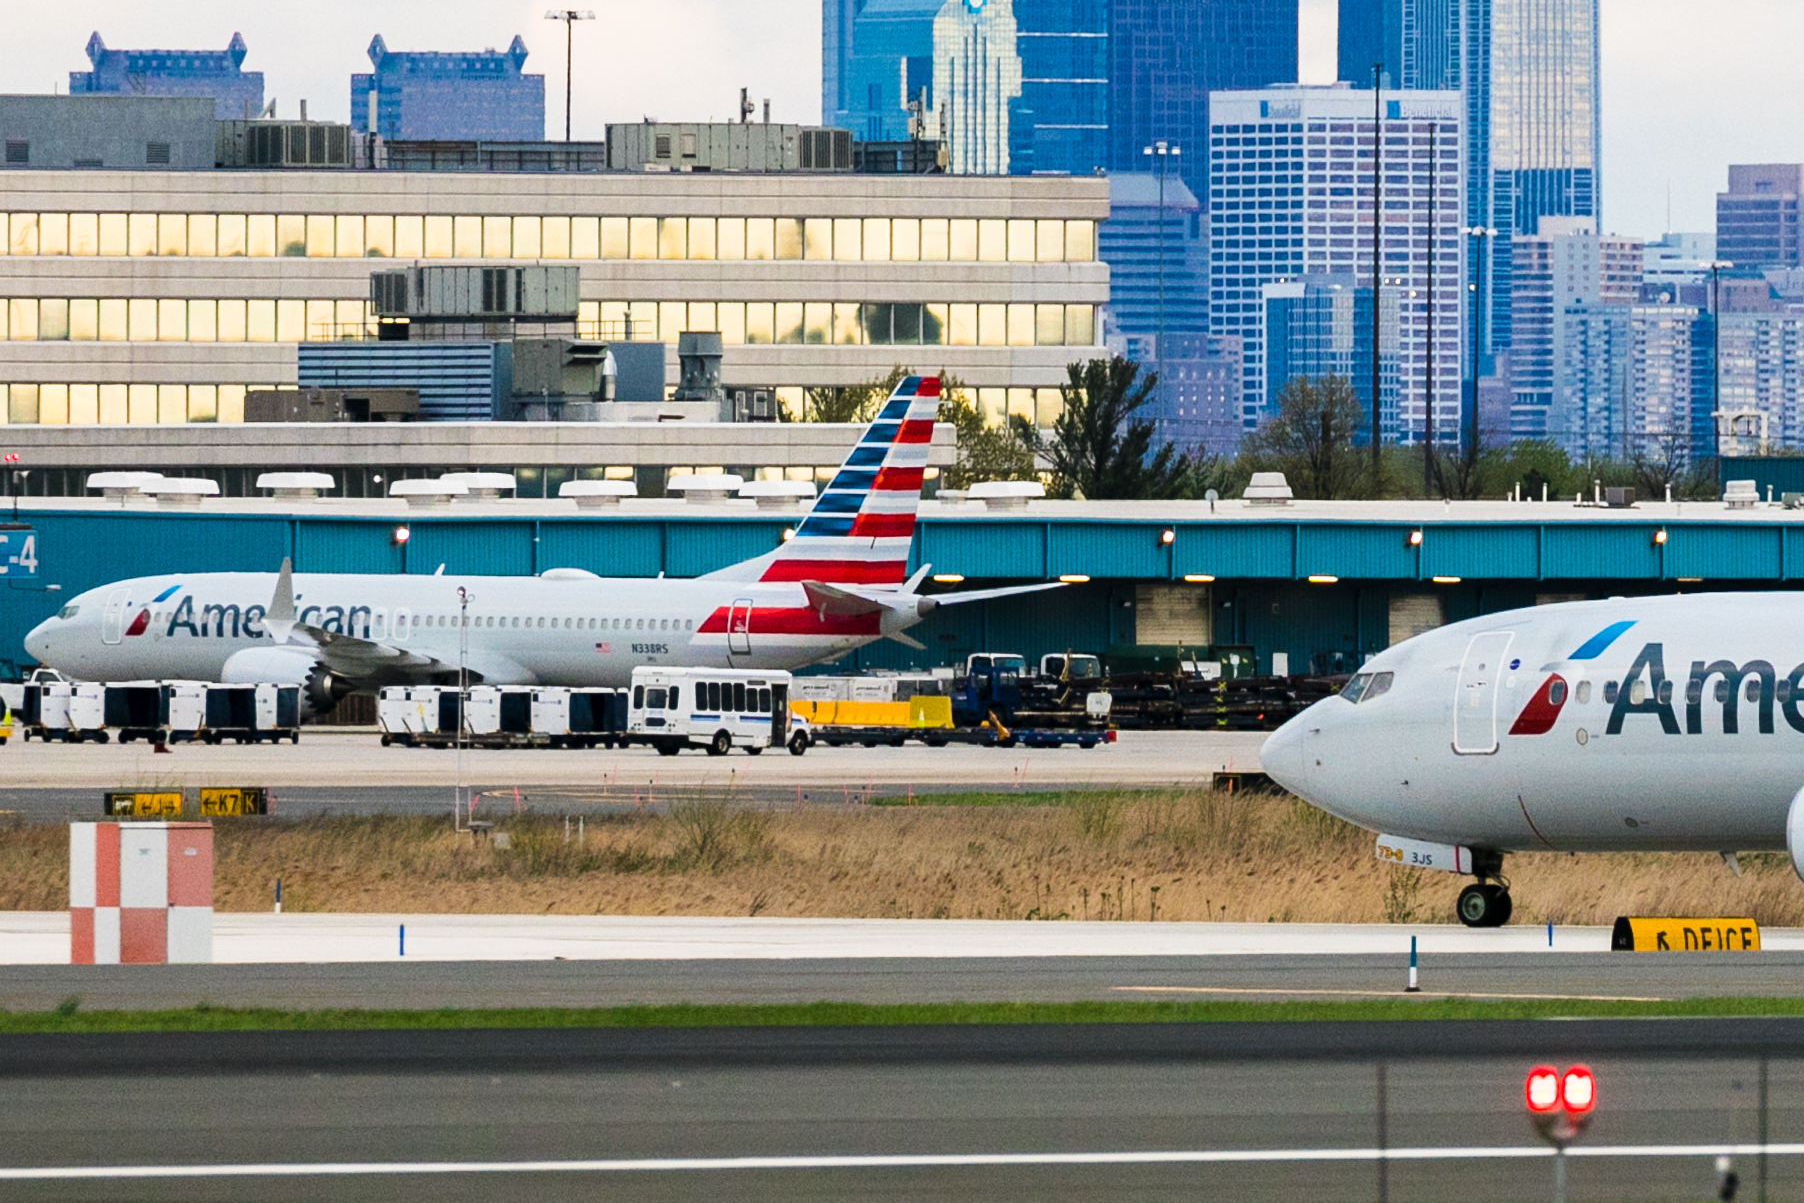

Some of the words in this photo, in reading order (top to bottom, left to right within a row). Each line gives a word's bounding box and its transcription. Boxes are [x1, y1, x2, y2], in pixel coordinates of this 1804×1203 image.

[1401, 105, 1455, 118] Beneficial
[166, 594, 372, 639] Amecan
[631, 643, 669, 654] N338RS
[218, 794, 239, 815] K7
[245, 793, 256, 814] K
[1412, 851, 1433, 865] 3JS
